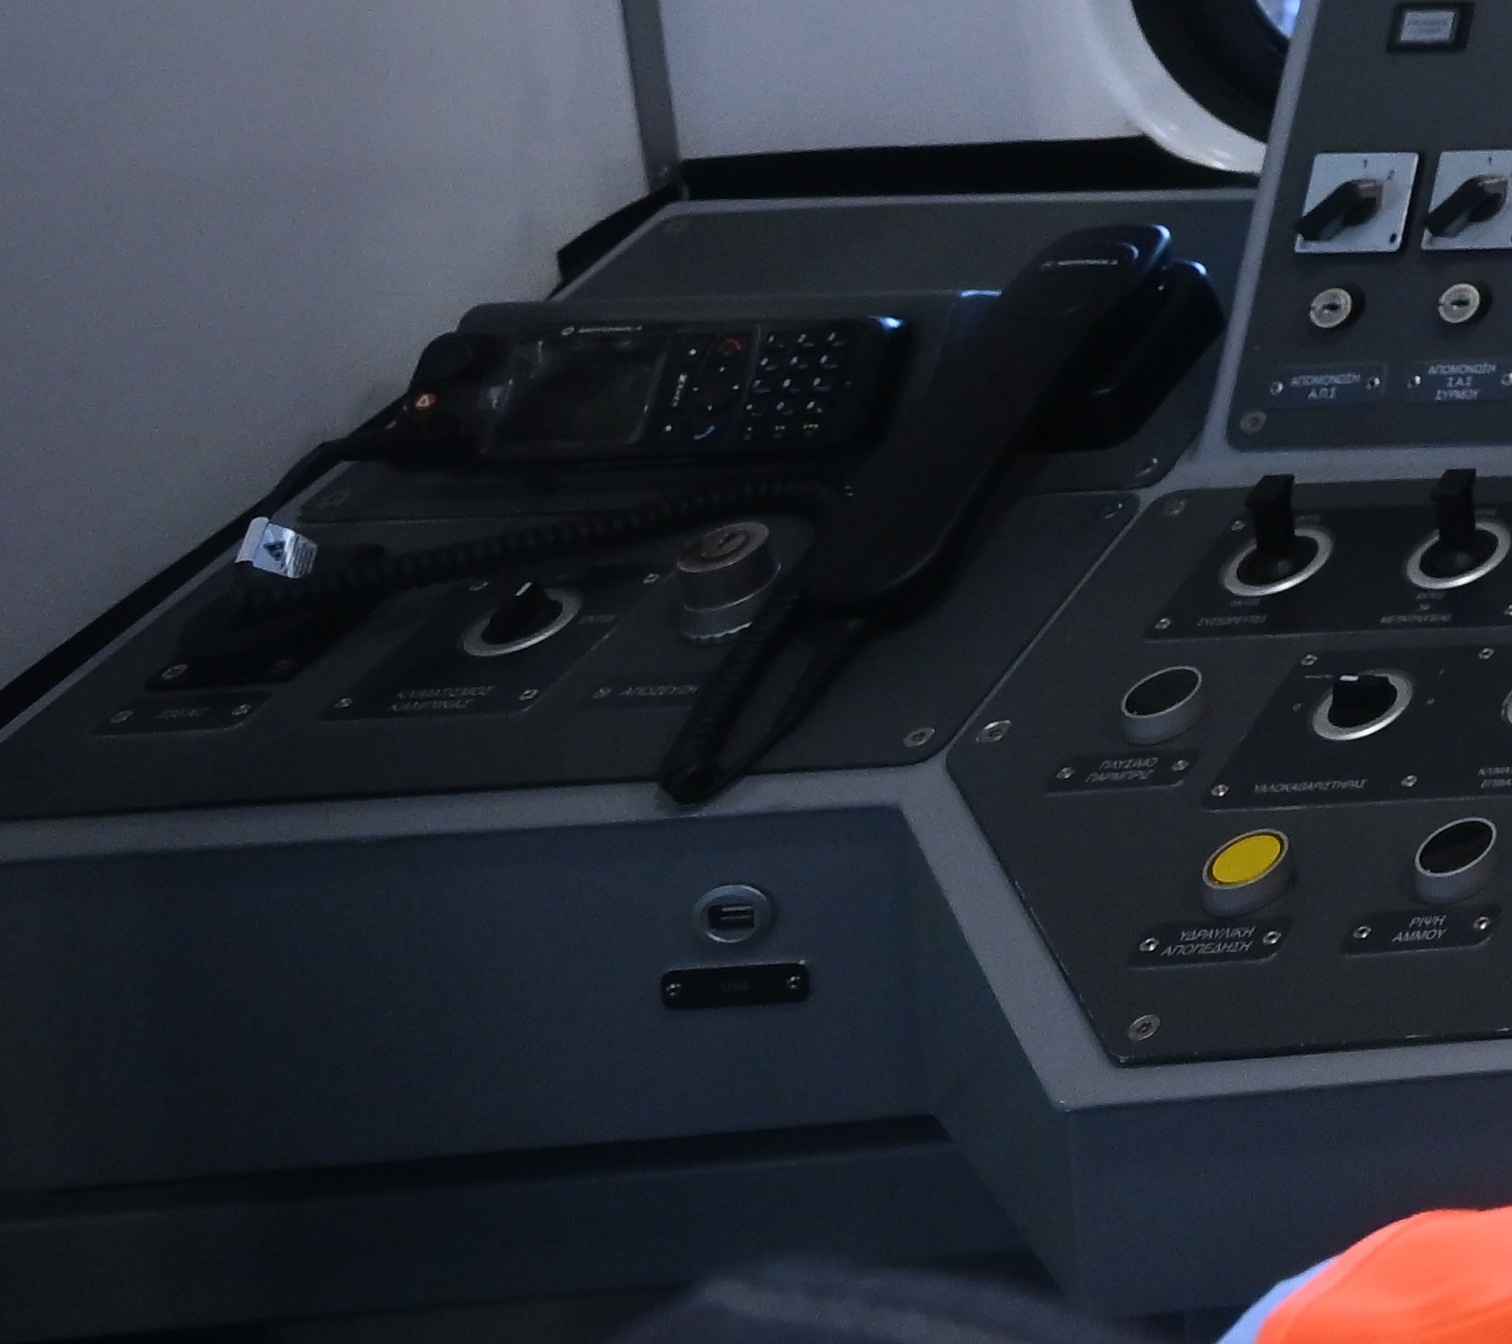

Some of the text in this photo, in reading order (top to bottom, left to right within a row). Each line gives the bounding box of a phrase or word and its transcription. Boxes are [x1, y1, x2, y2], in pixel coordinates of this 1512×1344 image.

[1408, 914, 1448, 929] ΡΙΨΗ
[1179, 926, 1256, 942] ΥΔΡΑΥΛΙΚΗ
[1391, 927, 1448, 943] ΑΜΜΟΥ
[1159, 941, 1253, 958] ΑΠΟΠΕΔΗΣΗ
